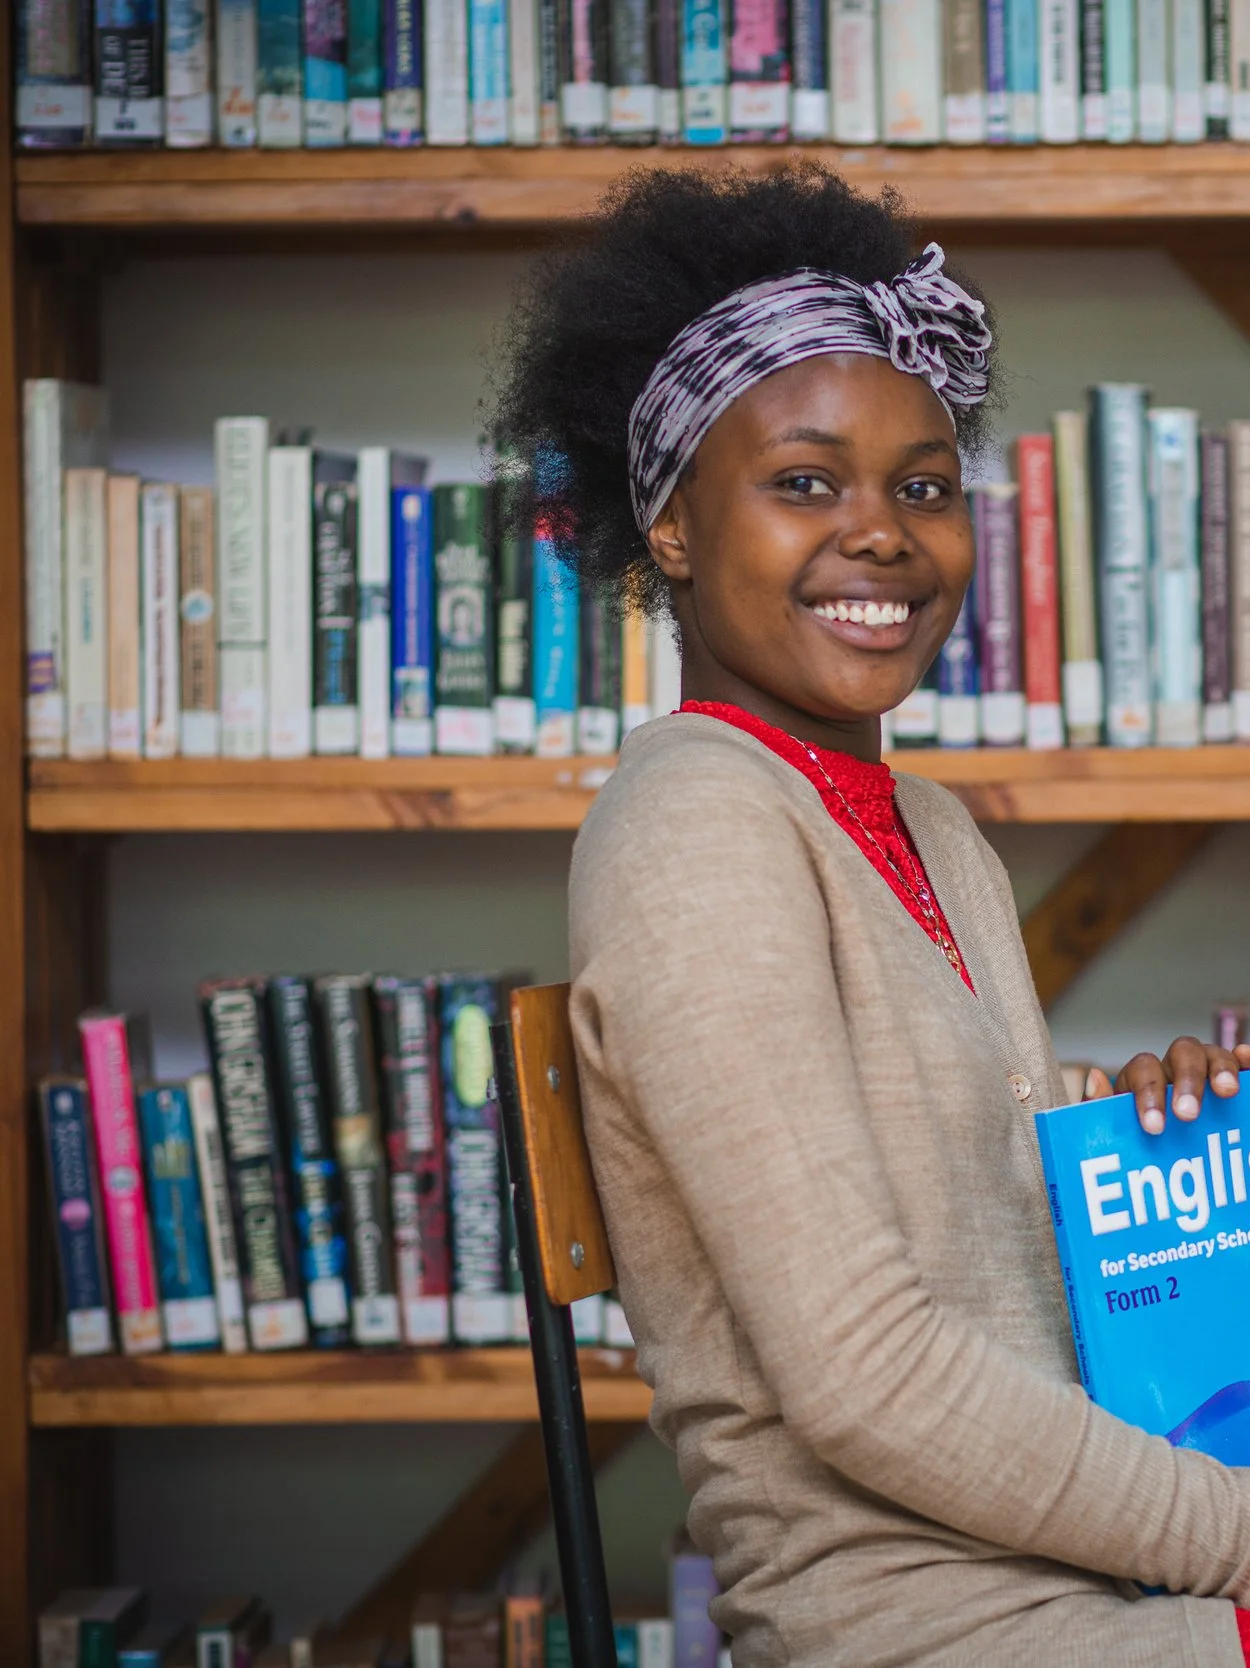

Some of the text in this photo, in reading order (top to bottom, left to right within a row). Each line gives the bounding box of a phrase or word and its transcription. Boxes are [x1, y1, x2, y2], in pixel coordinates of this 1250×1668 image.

[1100, 1258, 1127, 1278] for
[1127, 1238, 1216, 1272] Secondary
[1049, 1183, 1090, 1386] English for Secondary Schools
[1105, 1275, 1181, 1315] Form 2
